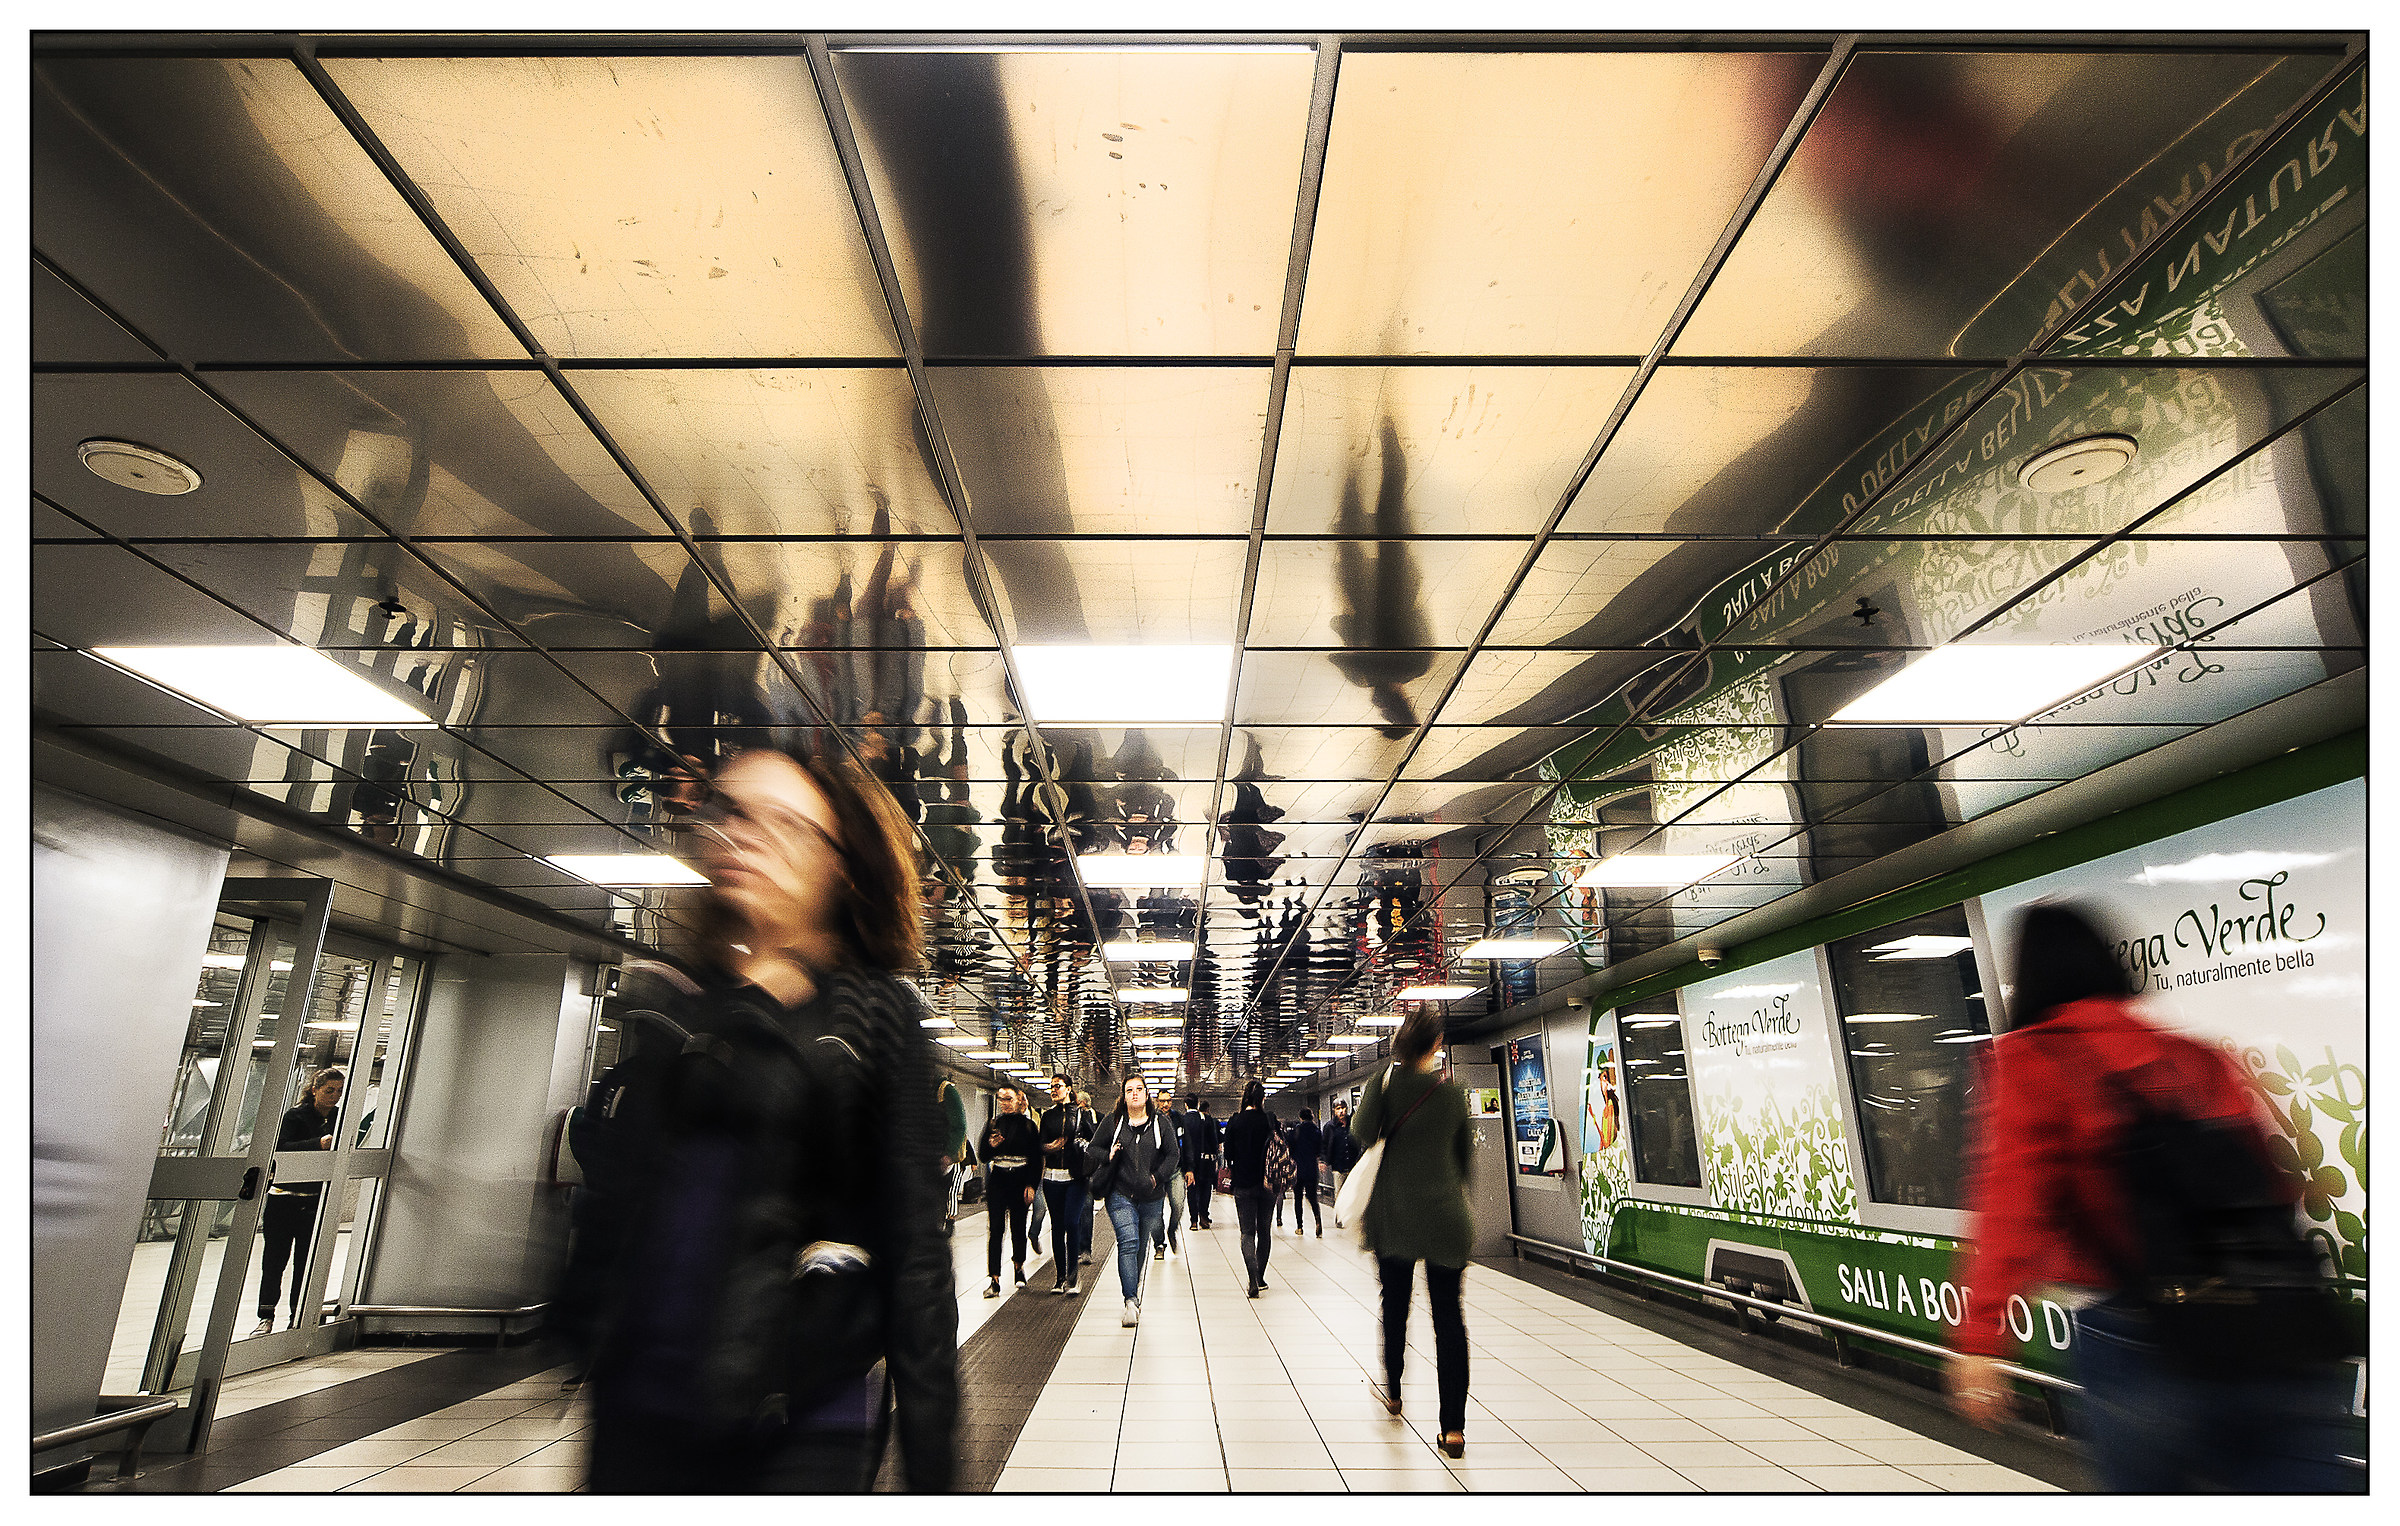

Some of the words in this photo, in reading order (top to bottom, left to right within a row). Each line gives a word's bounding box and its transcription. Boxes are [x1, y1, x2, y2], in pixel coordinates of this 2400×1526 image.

[2174, 870, 2326, 959] Verde
[2152, 973, 2173, 991] Tu,
[2176, 957, 2272, 988] naturalmente
[2275, 949, 2315, 972] bella
[1702, 1010, 1750, 1057] Bottega
[1751, 993, 1801, 1035] Verde
[1837, 1263, 1890, 1311] SALI
[1897, 1274, 1917, 1317] A
[1919, 1277, 2034, 1343] BOO
